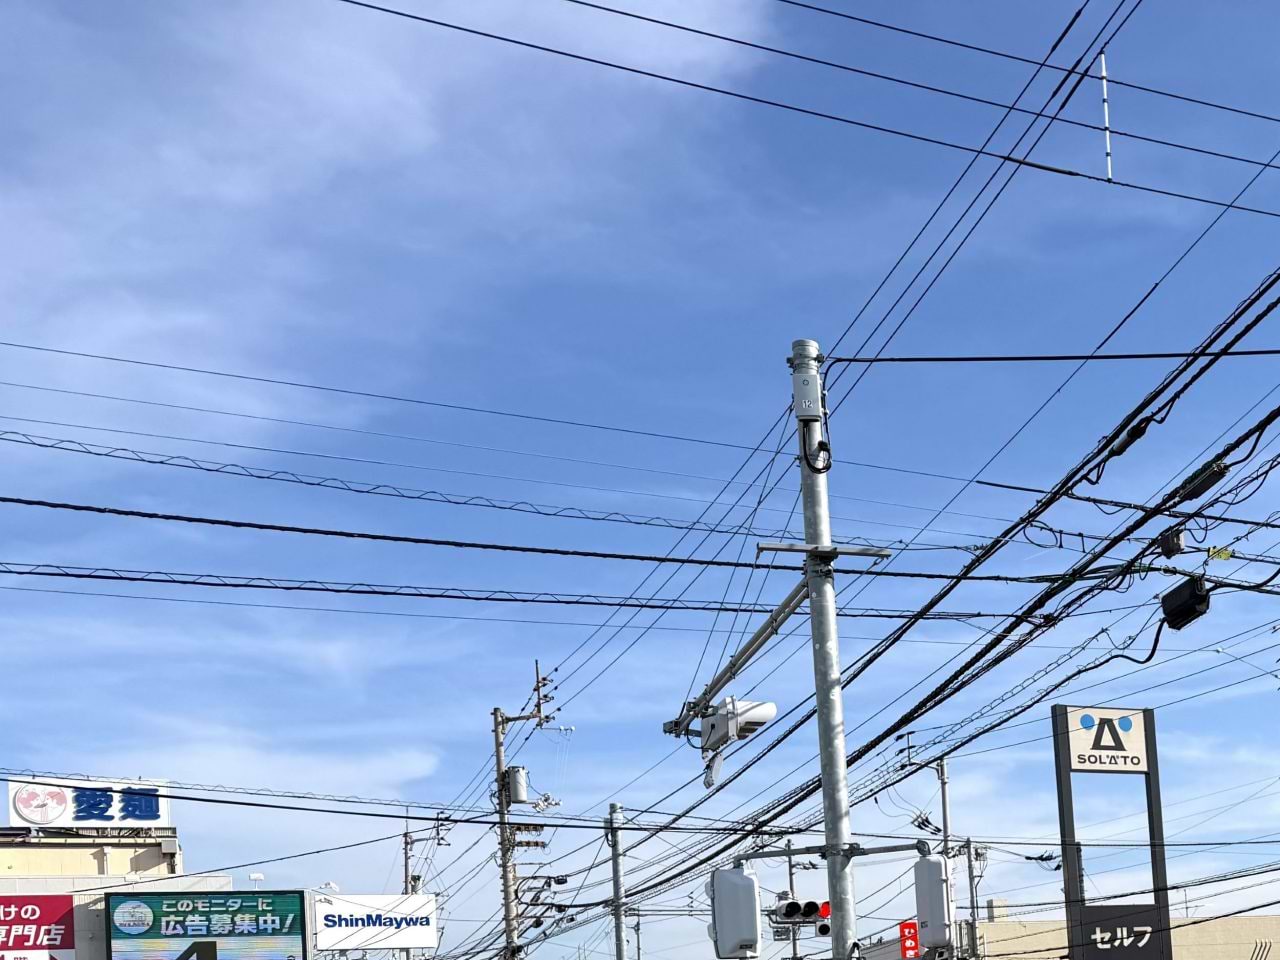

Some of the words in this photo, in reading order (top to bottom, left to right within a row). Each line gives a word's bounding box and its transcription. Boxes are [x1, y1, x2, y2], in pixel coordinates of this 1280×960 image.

[162, 898, 273, 912] このモニターに
[323, 914, 431, 929] ShinMaywa
[1091, 926, 1153, 949] セルフ
